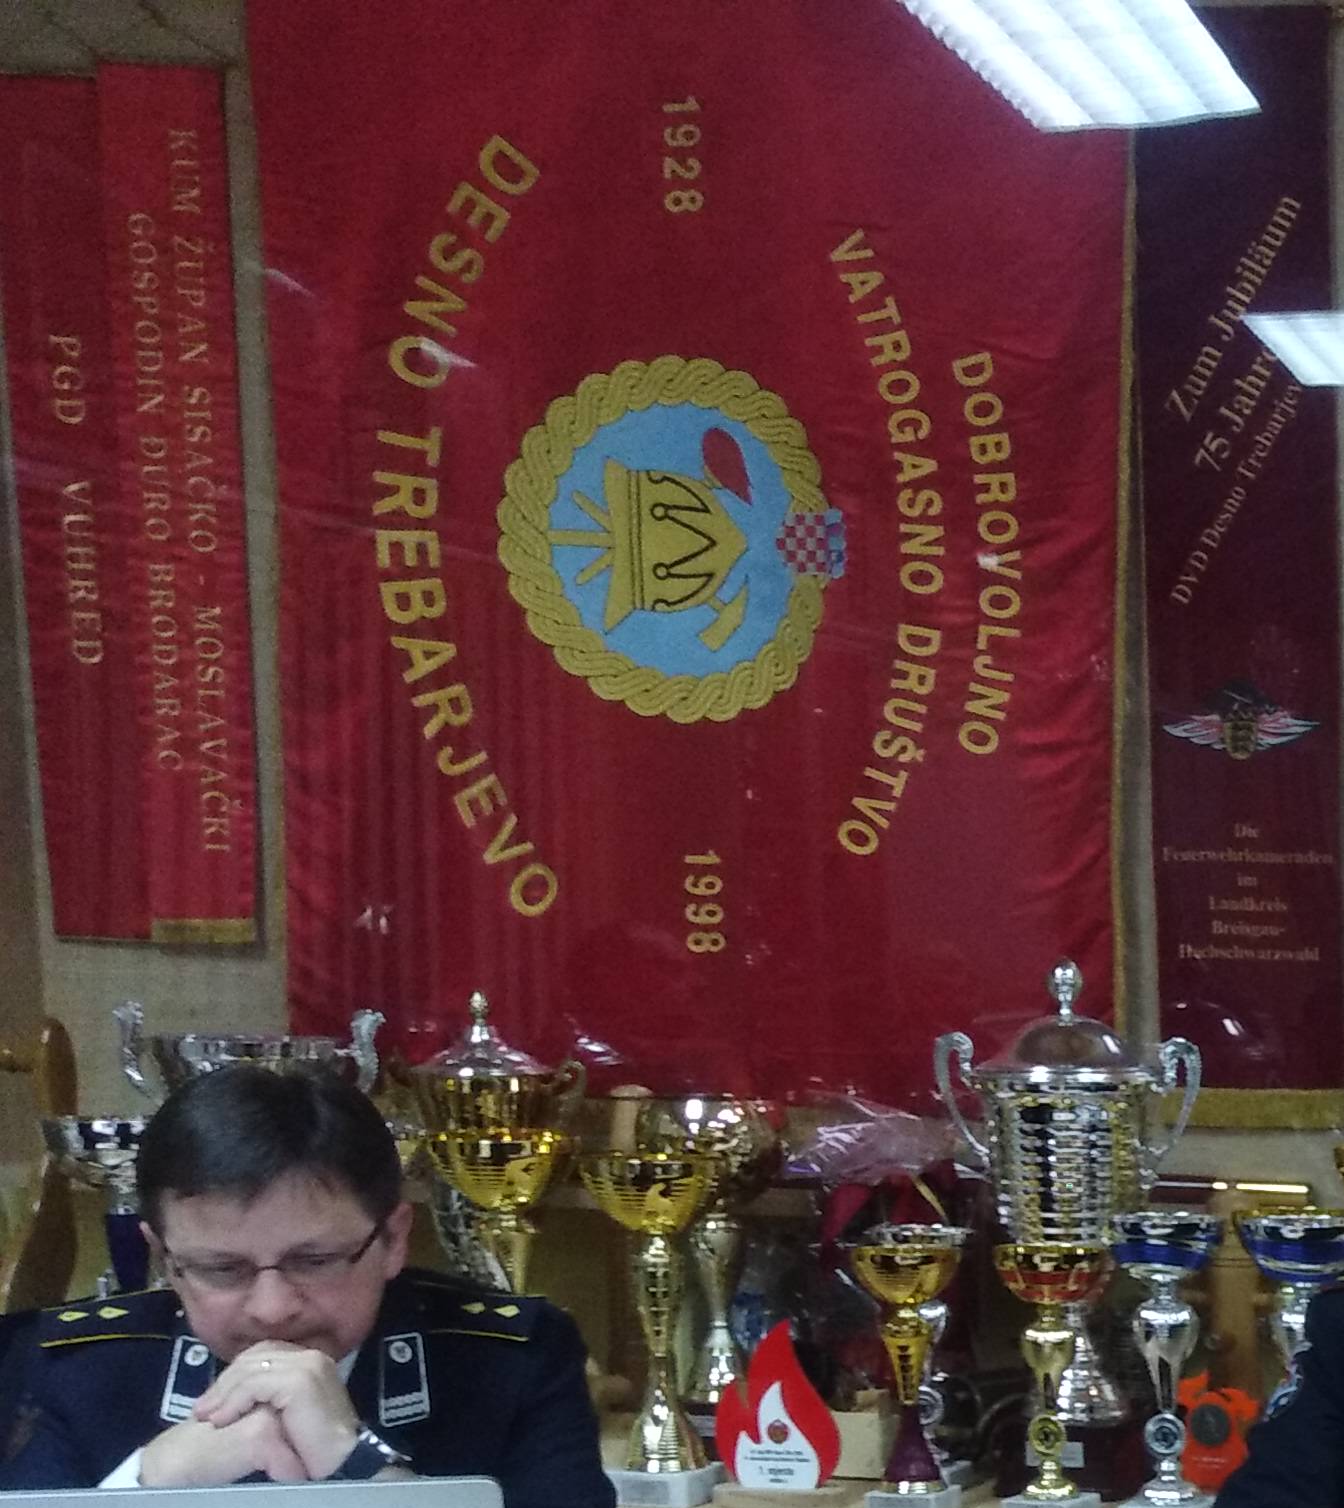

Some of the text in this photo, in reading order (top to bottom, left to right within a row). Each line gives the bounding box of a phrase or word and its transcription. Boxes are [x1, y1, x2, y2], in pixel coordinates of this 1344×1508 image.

[168, 127, 200, 219] KUM
[662, 96, 703, 215] 1928
[170, 232, 209, 366] ŽUPAN
[1165, 196, 1301, 423] Zum Jubiläum
[48, 334, 104, 668] PGD VUHRED
[127, 211, 161, 416] GOSPODIN
[148, 562, 185, 773] BRODARAC
[184, 384, 220, 556] SISAČKO
[371, 134, 560, 918] DESNO TREBARJEVO
[829, 228, 946, 858] VATROGASNO DRUŠTVO
[1194, 431, 1231, 472] 75
[1202, 485, 1247, 549] Desno
[951, 351, 1024, 757] DOBROVOLJNO
[193, 603, 233, 855] MOSLAVAČKI
[684, 849, 724, 955] 1998
